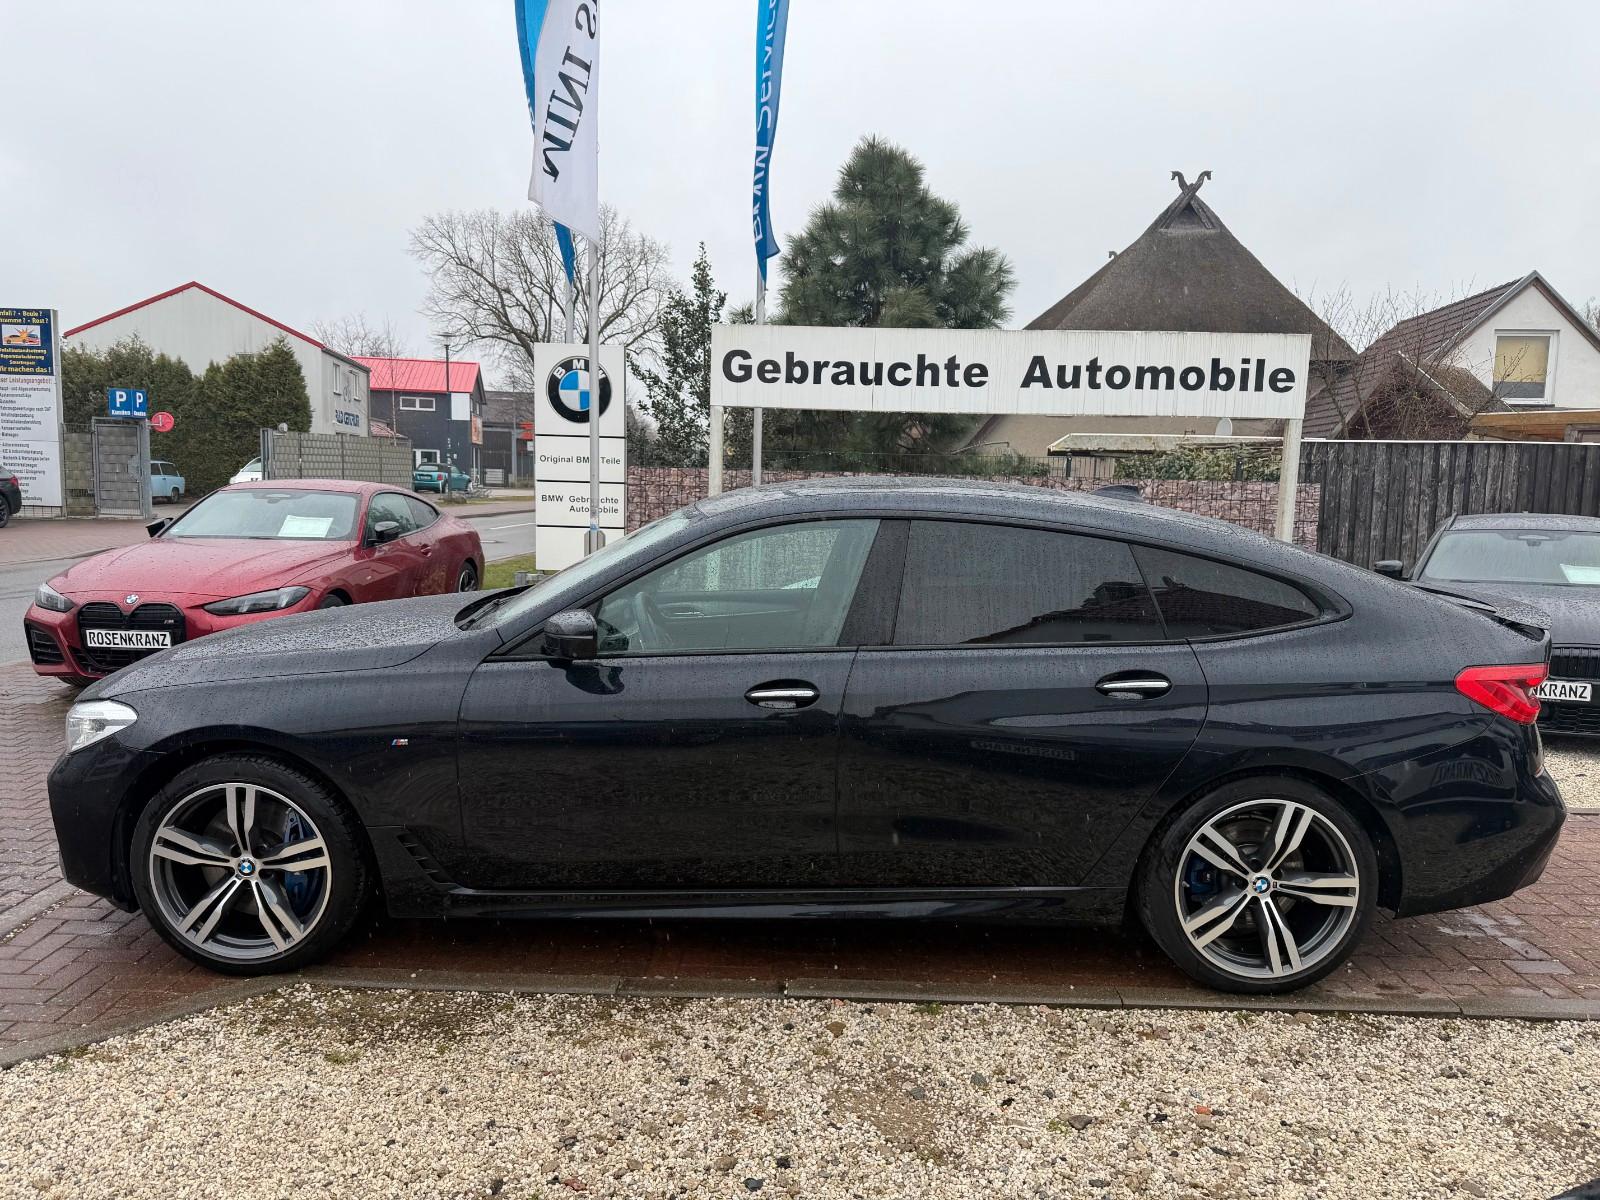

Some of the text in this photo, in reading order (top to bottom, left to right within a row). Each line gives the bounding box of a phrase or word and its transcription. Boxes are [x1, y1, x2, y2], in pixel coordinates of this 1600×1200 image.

[722, 349, 1296, 393] Gebrauchte Automobile
[115, 390, 127, 408] P
[136, 391, 144, 408] P
[540, 455, 621, 465] Original BM Teile
[541, 494, 619, 504] BMW Gebrchte
[569, 505, 619, 514] Autoobile
[88, 631, 169, 648] ROSENKRANZ
